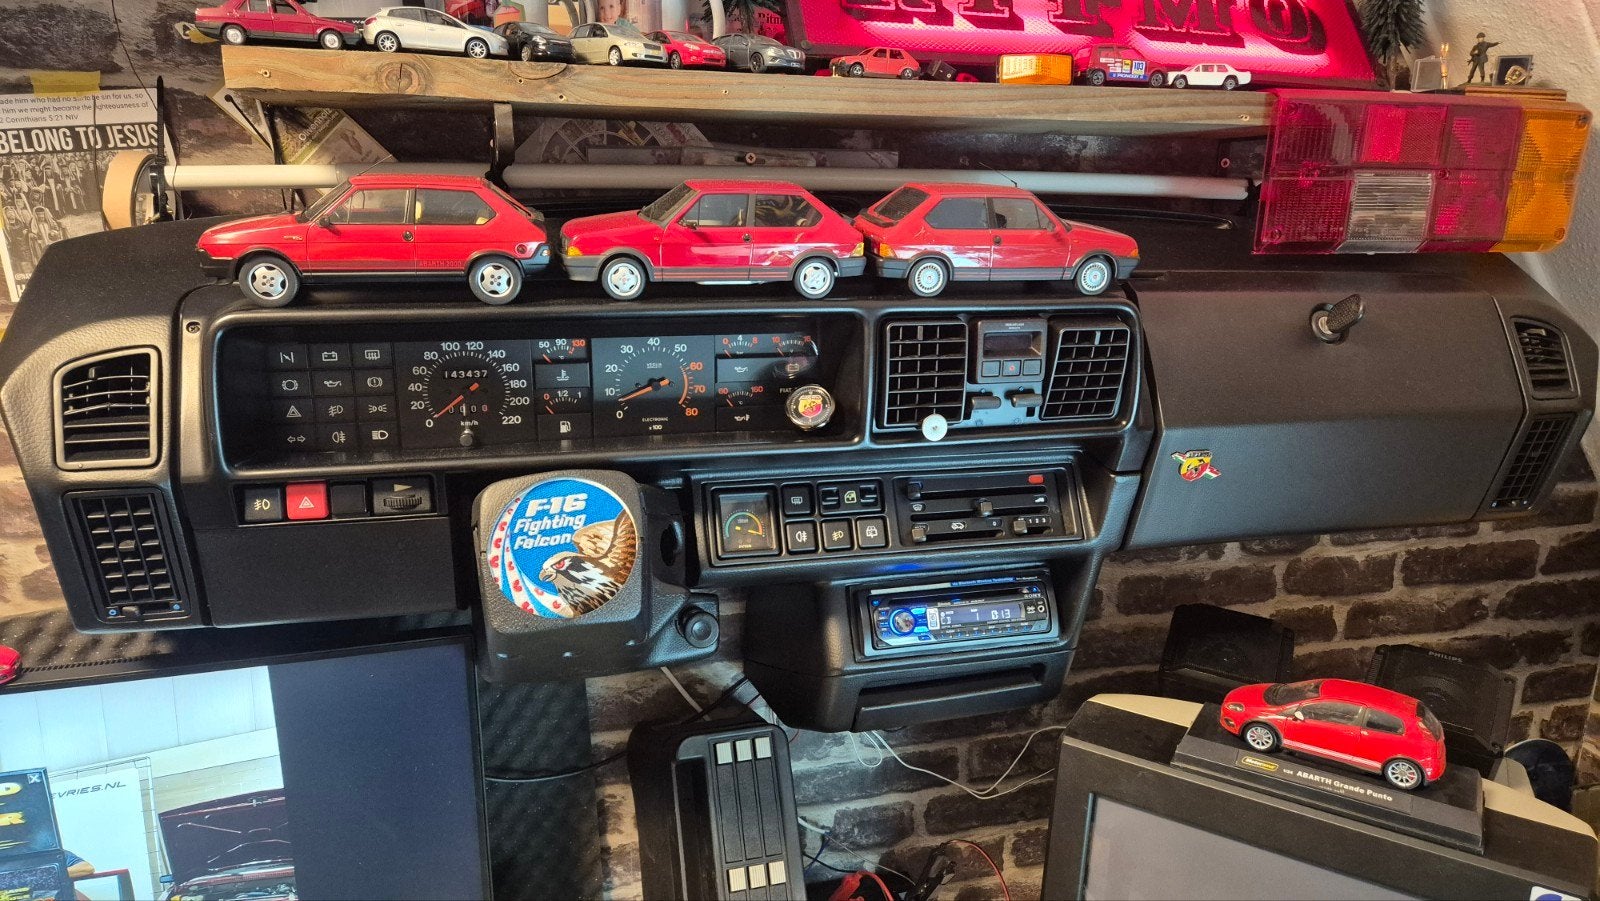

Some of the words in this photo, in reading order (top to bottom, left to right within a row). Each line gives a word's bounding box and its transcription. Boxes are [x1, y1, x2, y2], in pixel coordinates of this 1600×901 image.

[1134, 61, 1144, 70] 103
[30, 106, 51, 114] might
[93, 102, 141, 111] ighteousness
[0, 128, 74, 154] BELONG
[75, 126, 102, 150] TO
[105, 123, 158, 149] JESUS
[465, 341, 484, 350] 120
[538, 341, 550, 349] 50
[555, 338, 566, 346] 90
[571, 339, 586, 347] 130
[647, 337, 660, 346] 40
[440, 342, 460, 351] 100
[620, 344, 634, 354] 30
[674, 343, 687, 352] 50
[423, 351, 439, 361] 80
[487, 350, 506, 359] 140
[412, 366, 427, 375] 60
[502, 363, 520, 372] 160
[605, 364, 618, 373] 20
[689, 362, 703, 371] 60
[444, 370, 488, 379] 143437
[407, 382, 423, 392] 40
[509, 379, 527, 388] 180
[604, 387, 616, 396] 10
[693, 385, 706, 394] 70
[410, 401, 425, 410] 20
[509, 396, 530, 406] 200
[615, 411, 623, 419] 0
[685, 407, 699, 417] 80
[425, 419, 434, 428] 0
[502, 415, 522, 425] 220
[525, 493, 588, 518] F-16
[514, 514, 586, 536] Fighting
[514, 532, 573, 550] Falcon
[1428, 650, 1463, 664] PHILIPS
[1296, 770, 1332, 786] ABARTH
[1333, 780, 1365, 794] Grande
[1366, 789, 1393, 802] Punto
